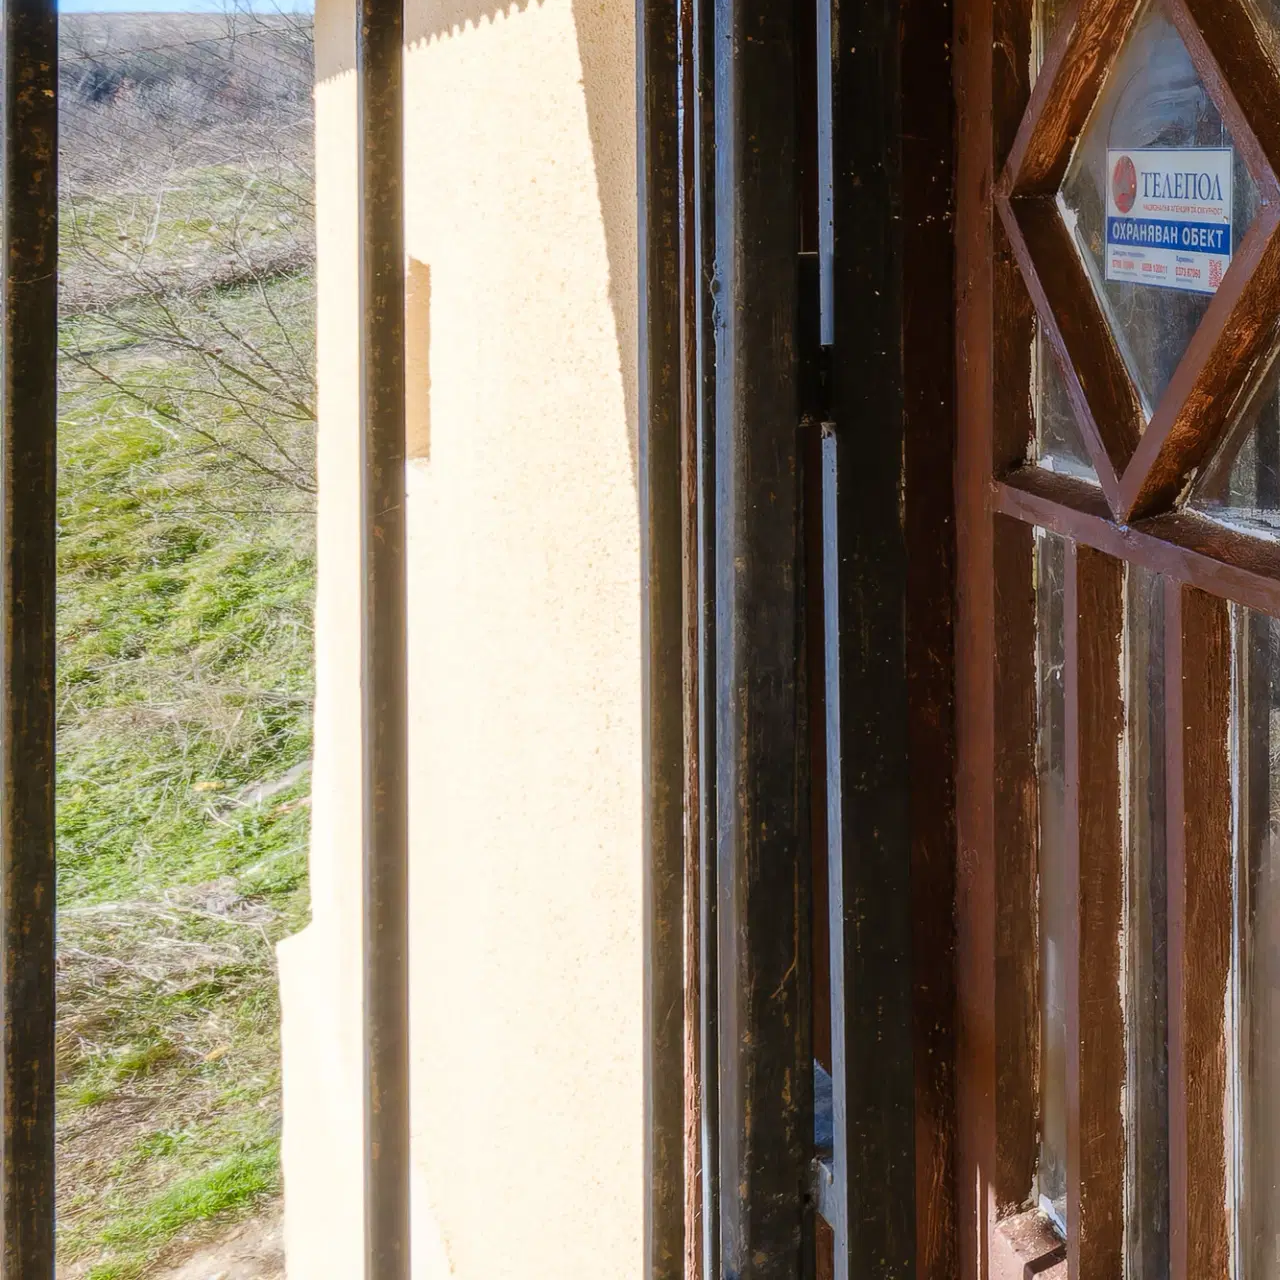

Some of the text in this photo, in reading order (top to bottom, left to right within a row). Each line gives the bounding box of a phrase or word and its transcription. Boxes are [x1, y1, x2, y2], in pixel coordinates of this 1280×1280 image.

[1141, 171, 1223, 201] ТЕЛЕПОЛ
[1112, 222, 1224, 248] ОХРАНЯВАН ОБЕКТ
